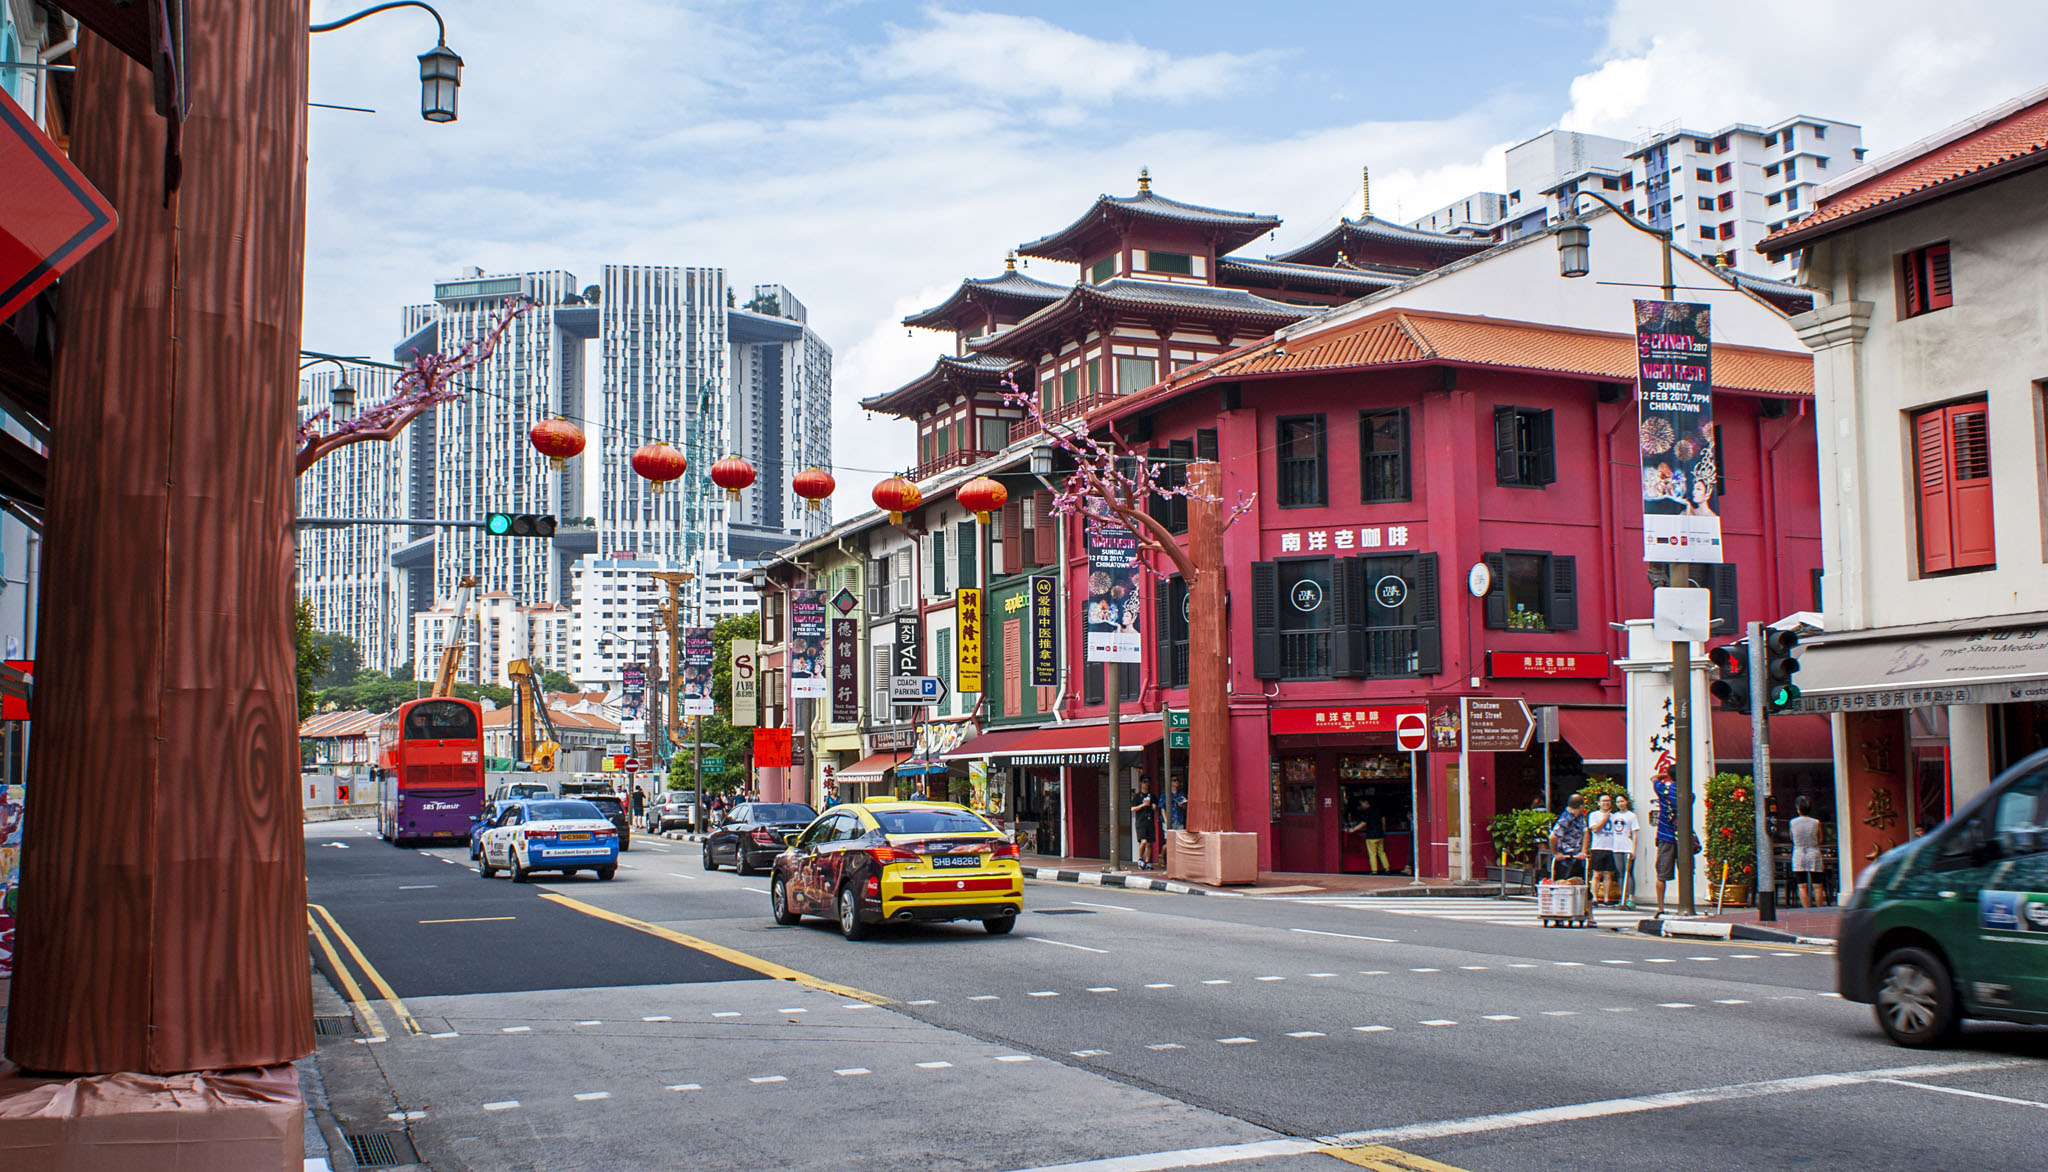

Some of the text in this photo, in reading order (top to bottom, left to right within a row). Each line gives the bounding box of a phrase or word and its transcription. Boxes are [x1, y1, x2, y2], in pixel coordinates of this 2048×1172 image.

[1643, 363, 1706, 382] NIGHT FIESTA
[1657, 381, 1691, 392] SUNDAY
[1650, 392, 1668, 401] FEB
[1691, 394, 1710, 403] 7PM
[1649, 402, 1700, 413] CHINATOWN
[1113, 537, 1136, 549] FIESTA
[1281, 526, 1408, 552] 南洋老咖啡
[1037, 595, 1052, 660] 爱康中医推拿
[901, 625, 915, 644] 치킨
[1940, 642, 2048, 657] Thye Shan Medical
[894, 688, 920, 696] PARKING
[924, 682, 933, 692] P
[1172, 715, 1188, 725] Sm
[1470, 711, 1502, 719] Food Street
[1034, 755, 1065, 765] NANYANG
[1068, 754, 1083, 764] OLD
[1086, 753, 1110, 763] COFFE
[430, 801, 459, 811] Transit
